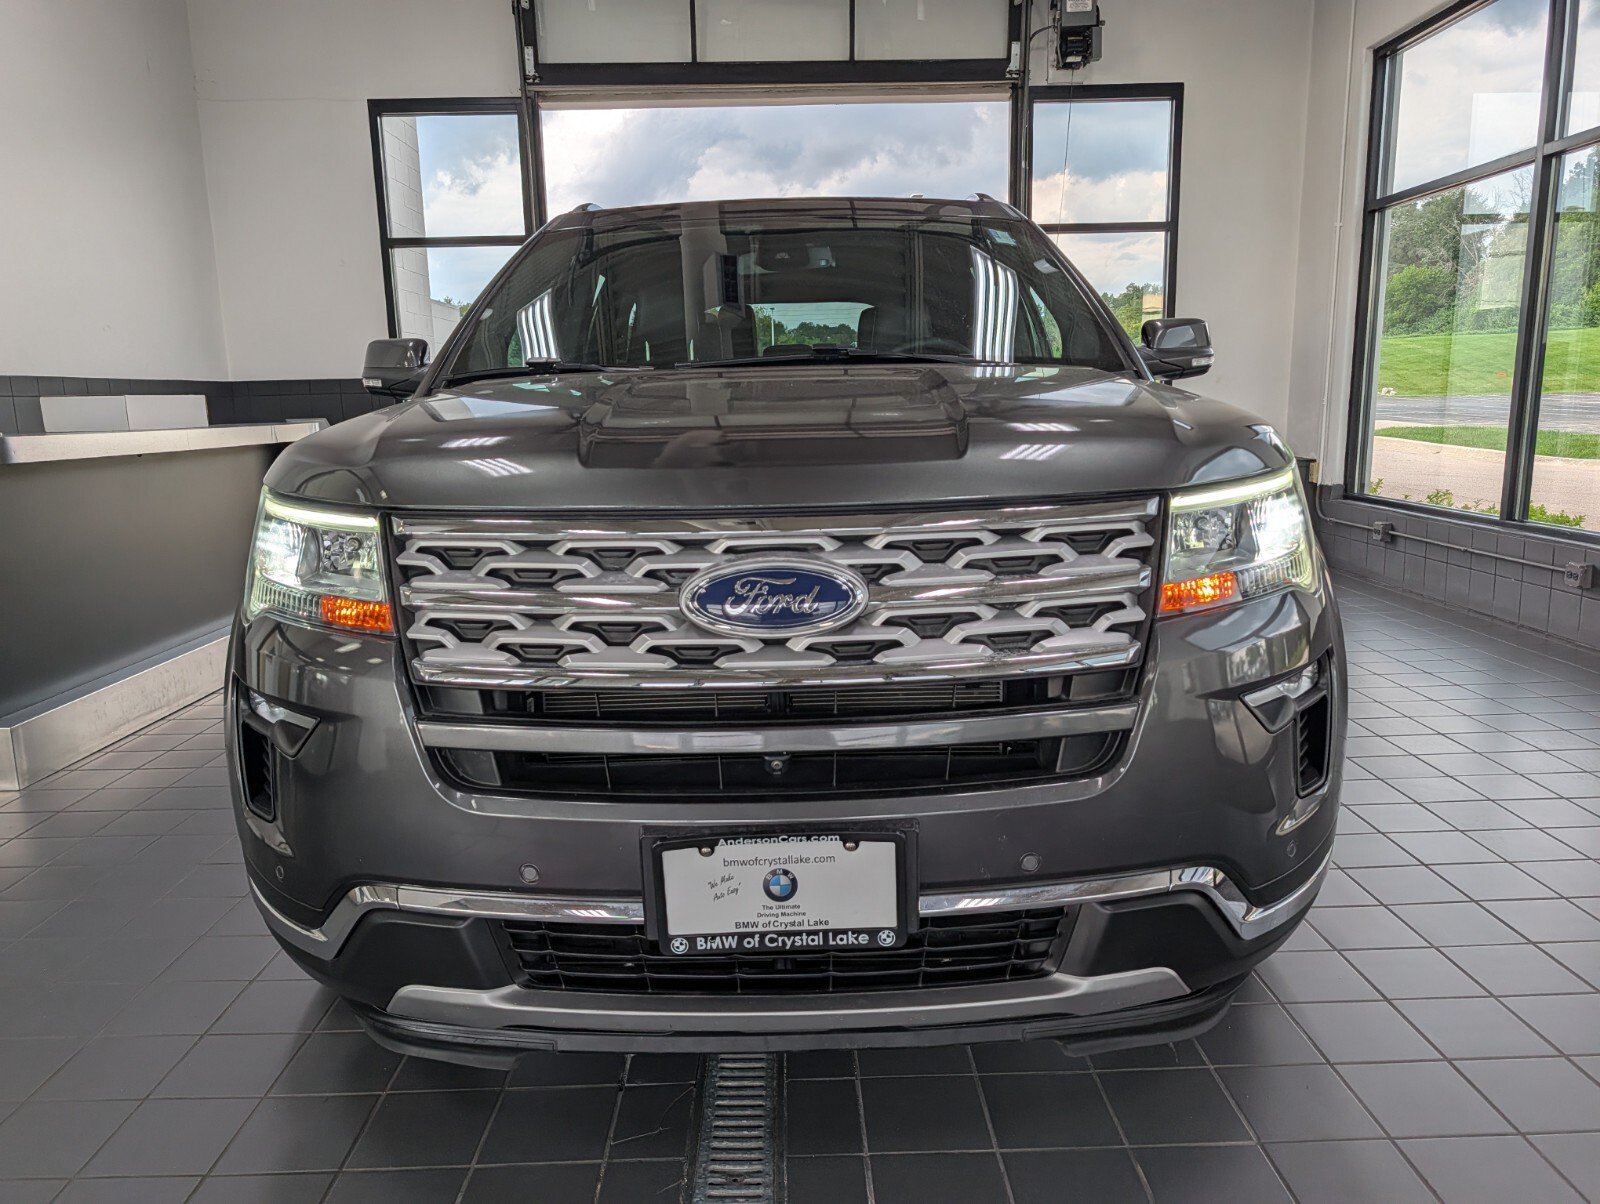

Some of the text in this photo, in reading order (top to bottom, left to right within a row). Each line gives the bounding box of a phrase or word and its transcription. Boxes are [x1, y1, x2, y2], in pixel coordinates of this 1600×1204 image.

[721, 576, 820, 616] Ford
[718, 835, 840, 846] AndersonCars.com
[723, 854, 836, 867] bmwofcrystallake.com
[765, 868, 796, 881] BMW
[775, 903, 801, 911] Ultimate
[735, 918, 830, 930] BMW of Crystal Lake
[696, 930, 870, 950] BMW of Crystal Lake
